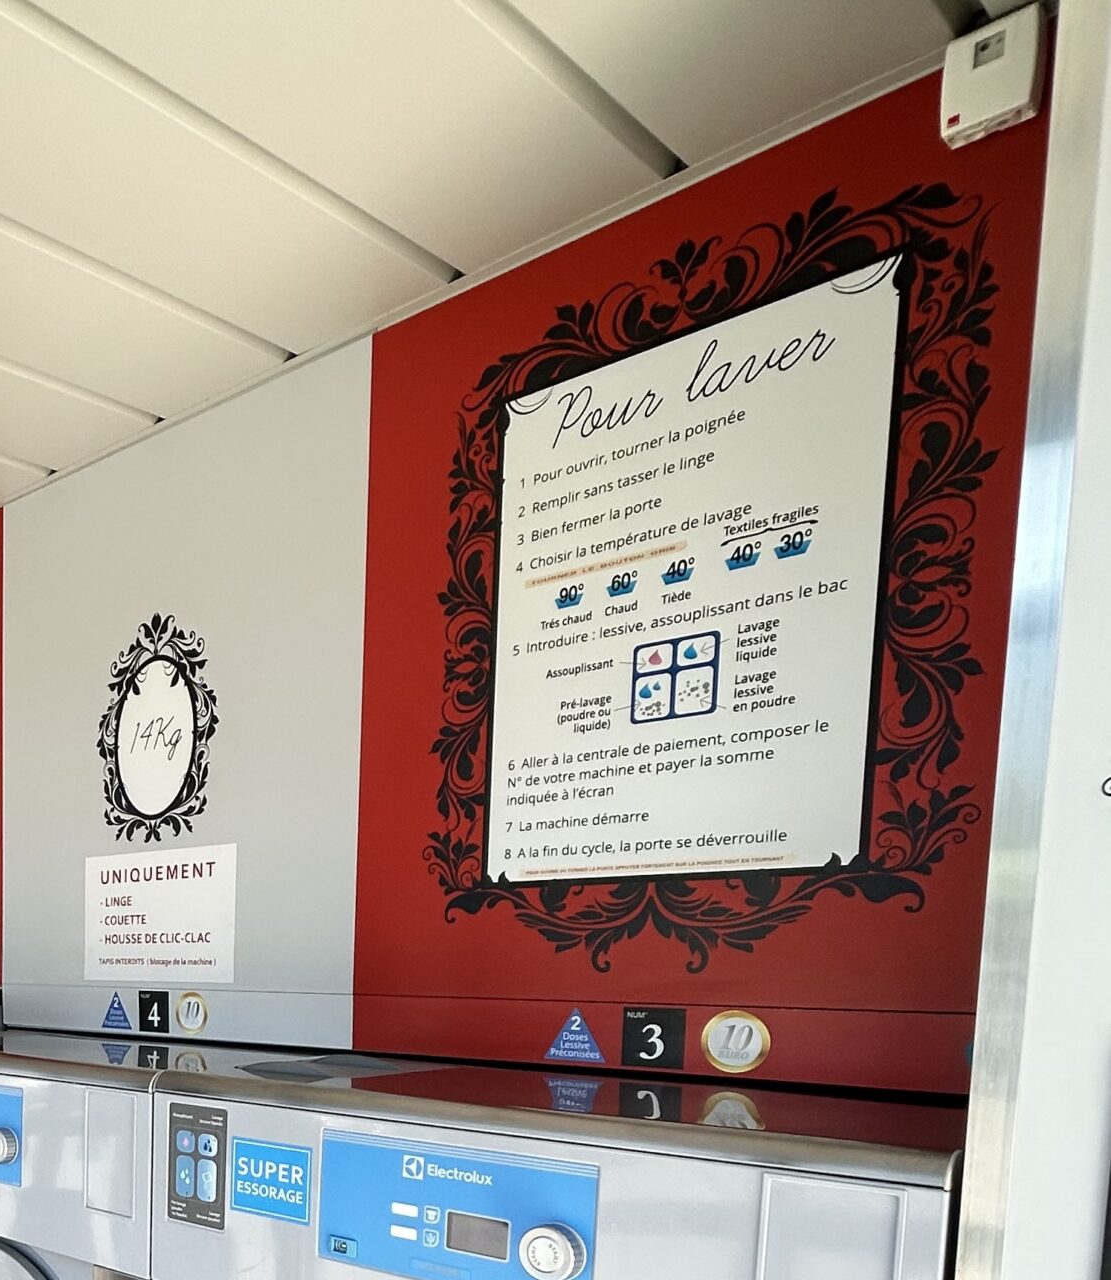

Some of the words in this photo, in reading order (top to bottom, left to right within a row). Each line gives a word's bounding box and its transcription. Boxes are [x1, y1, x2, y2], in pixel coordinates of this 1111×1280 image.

[553, 386, 663, 449] Pour
[687, 329, 835, 402] laver
[520, 478, 526, 489] 1
[533, 468, 563, 485] Pour
[566, 454, 608, 475] ouvrir,
[612, 435, 665, 461] tourner
[668, 430, 681, 444] la
[685, 410, 746, 442] poignée
[518, 506, 526, 518] 2
[532, 490, 580, 514] Remplir
[584, 483, 614, 500] sans
[618, 467, 660, 489] tasser
[663, 462, 675, 476] le
[679, 451, 715, 471] linge
[517, 534, 525, 546] 3
[531, 526, 558, 543] Bien
[562, 515, 607, 536] fermer
[609, 508, 621, 521] la
[624, 497, 662, 520] porte
[724, 518, 768, 537] Textiles
[772, 504, 819, 524] fragiles
[515, 562, 523, 574] 4
[530, 550, 573, 571] Choisir
[576, 545, 587, 558] la
[590, 525, 677, 554] température
[681, 517, 699, 532] de
[703, 504, 752, 526] lavage
[559, 583, 585, 603] 90°
[610, 570, 638, 592] 60°
[665, 557, 695, 579] 40°
[730, 541, 762, 564] 40°
[779, 528, 812, 551] 30°
[512, 644, 520, 656] 5
[526, 630, 589, 654] Introduire
[599, 619, 647, 640] lessive,
[650, 599, 751, 629] assouplissant
[755, 588, 794, 608] dans
[798, 583, 813, 599] le
[818, 577, 849, 596] bac
[562, 611, 592, 627] chaud
[604, 600, 639, 617] Chaud
[661, 589, 692, 605] Tiède
[737, 618, 780, 635] Lavage
[736, 632, 778, 648] lessive
[735, 646, 778, 662] liquide
[545, 658, 614, 680] Assouplissant
[734, 670, 777, 687] Lavage
[733, 683, 774, 699] lessive
[560, 694, 612, 711] Pré-lavage
[733, 702, 748, 713] en
[751, 694, 796, 712] poudre
[557, 709, 595, 725] (poudre
[598, 708, 611, 718] ou
[573, 720, 611, 735] liquide)
[130, 716, 183, 761] 14Kg
[507, 759, 515, 771] 6
[521, 754, 549, 770] Aller
[551, 751, 559, 766] à
[562, 751, 573, 765] la
[577, 745, 630, 763] centrale
[633, 741, 651, 756] de
[654, 732, 726, 755] paiement,
[730, 722, 811, 747] composer
[815, 719, 830, 735] le
[507, 775, 522, 788] N°
[525, 773, 540, 787] de
[543, 769, 576, 785] votre
[580, 763, 635, 780] machine
[638, 761, 653, 774] et
[656, 757, 696, 776] payer
[699, 754, 712, 767] la
[716, 748, 775, 766] somme
[506, 790, 559, 807] indiquée
[561, 787, 570, 801] à
[573, 785, 614, 800] l'écran
[505, 822, 513, 834] 7
[519, 819, 532, 833] La
[536, 814, 589, 831] machine
[592, 810, 650, 827] démarre
[504, 848, 512, 860] 8
[517, 847, 527, 859] A
[528, 845, 539, 858] la
[542, 843, 559, 858] fin
[561, 842, 578, 856] du
[581, 840, 617, 859] cycle,
[619, 839, 631, 852] la
[635, 837, 673, 855] porte
[676, 837, 692, 849] se
[696, 829, 788, 847] déverrouille
[100, 861, 216, 885] UNIQUEMENT
[105, 896, 132, 907] LINGE
[104, 914, 147, 926] COUETTE
[104, 933, 142, 945] HOUSSE
[144, 933, 157, 944] DE
[159, 932, 211, 944] CLIC-CLAC
[173, 957, 180, 965] de
[181, 957, 186, 965] la
[113, 997, 119, 1008] 2
[186, 1001, 200, 1019] 10
[148, 1002, 161, 1027] 4
[571, 1015, 581, 1030] 2
[560, 1040, 591, 1050] Lessive
[562, 1032, 589, 1041] Doses
[639, 1023, 665, 1060] 3
[720, 1024, 754, 1051] 10
[550, 1047, 600, 1059] Préconisées
[718, 1050, 750, 1060] EURO
[238, 1156, 304, 1186] SUPER
[427, 1163, 493, 1186] Electrolux
[237, 1180, 304, 1205] ESSORAGE
